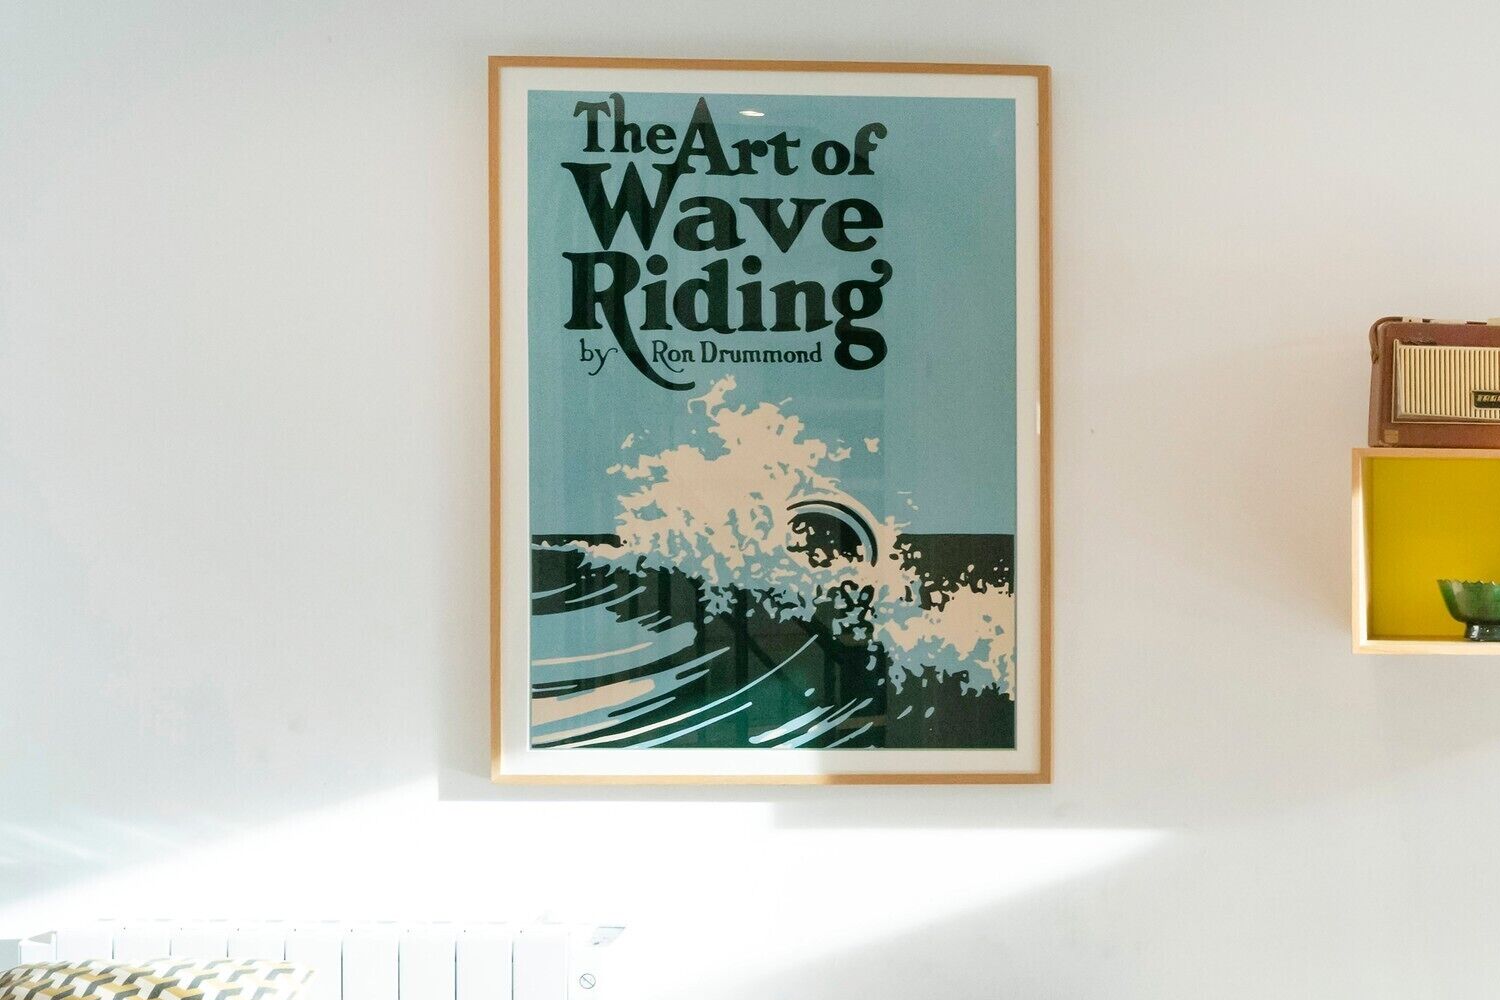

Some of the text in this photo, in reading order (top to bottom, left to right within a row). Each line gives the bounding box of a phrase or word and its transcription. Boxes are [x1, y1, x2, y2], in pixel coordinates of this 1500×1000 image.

[573, 92, 888, 176] The Art of
[561, 161, 884, 253] Wave
[562, 251, 893, 391] Riding
[579, 338, 822, 376] by Ron Drummond
